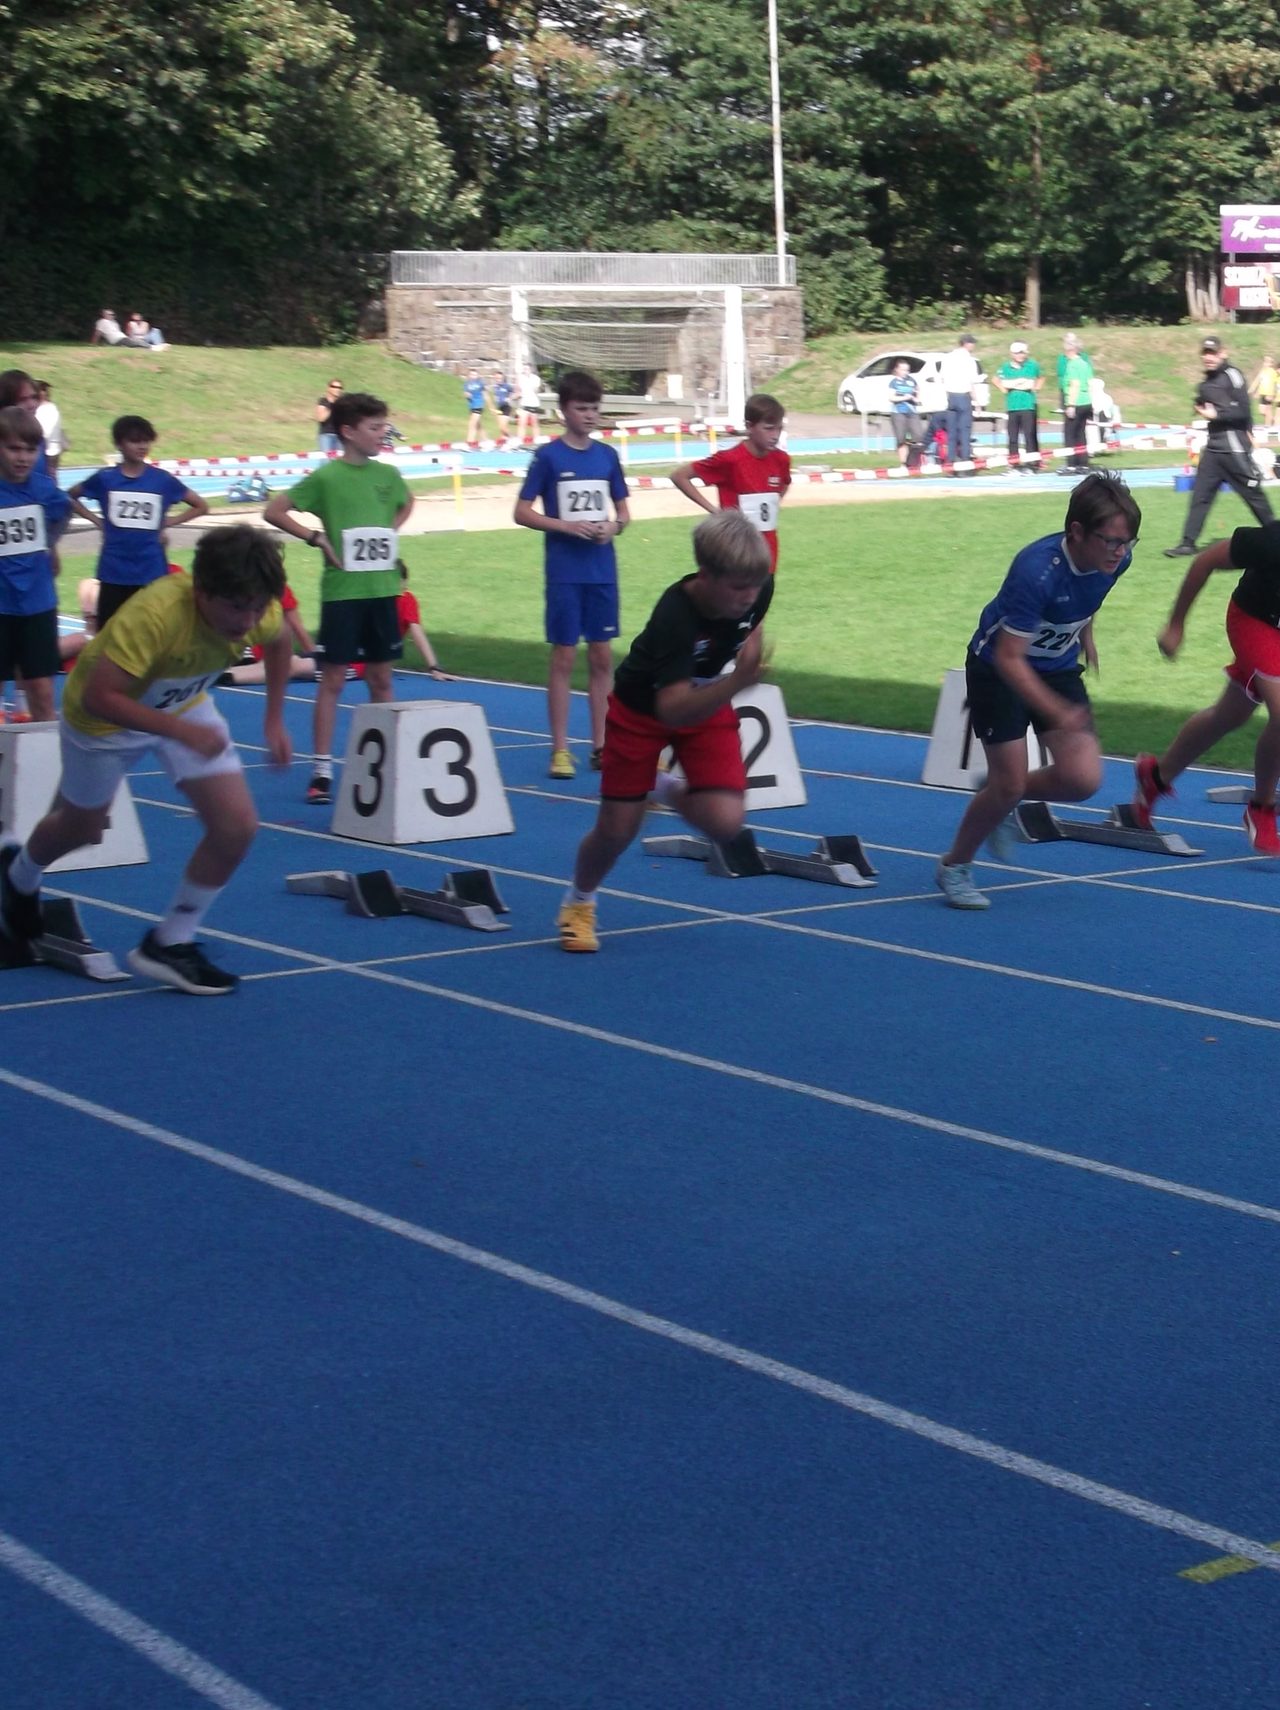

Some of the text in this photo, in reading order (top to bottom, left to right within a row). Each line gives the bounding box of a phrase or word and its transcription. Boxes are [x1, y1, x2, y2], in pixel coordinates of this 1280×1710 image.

[117, 500, 153, 520] 229
[568, 490, 604, 512] 220
[353, 537, 390, 561] 285
[353, 728, 386, 817] 3
[419, 727, 477, 817] 3
[736, 705, 778, 790] 2
